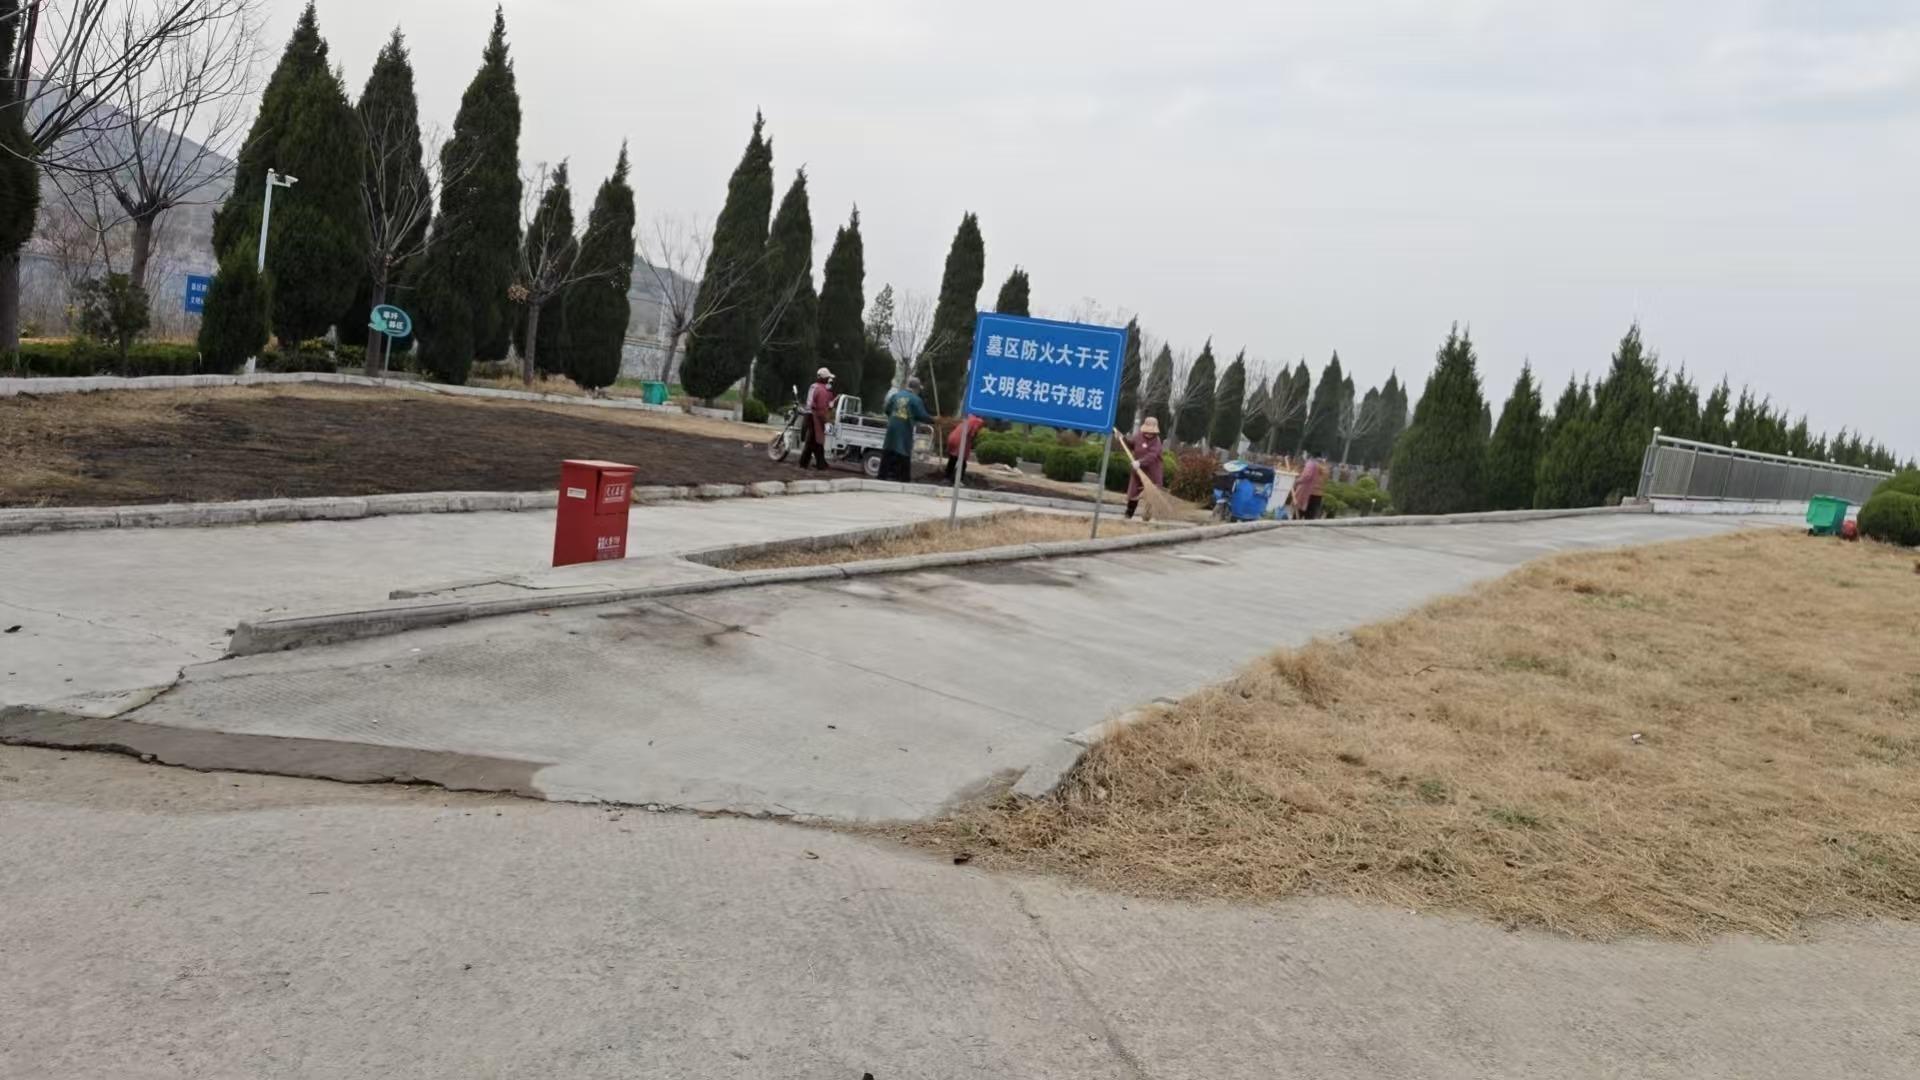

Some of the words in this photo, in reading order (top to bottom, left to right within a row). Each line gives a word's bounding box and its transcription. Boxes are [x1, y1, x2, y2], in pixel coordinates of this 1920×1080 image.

[986, 335, 1109, 370] 墓区防火大于天
[980, 373, 1104, 410] 文明祭祀守规范
